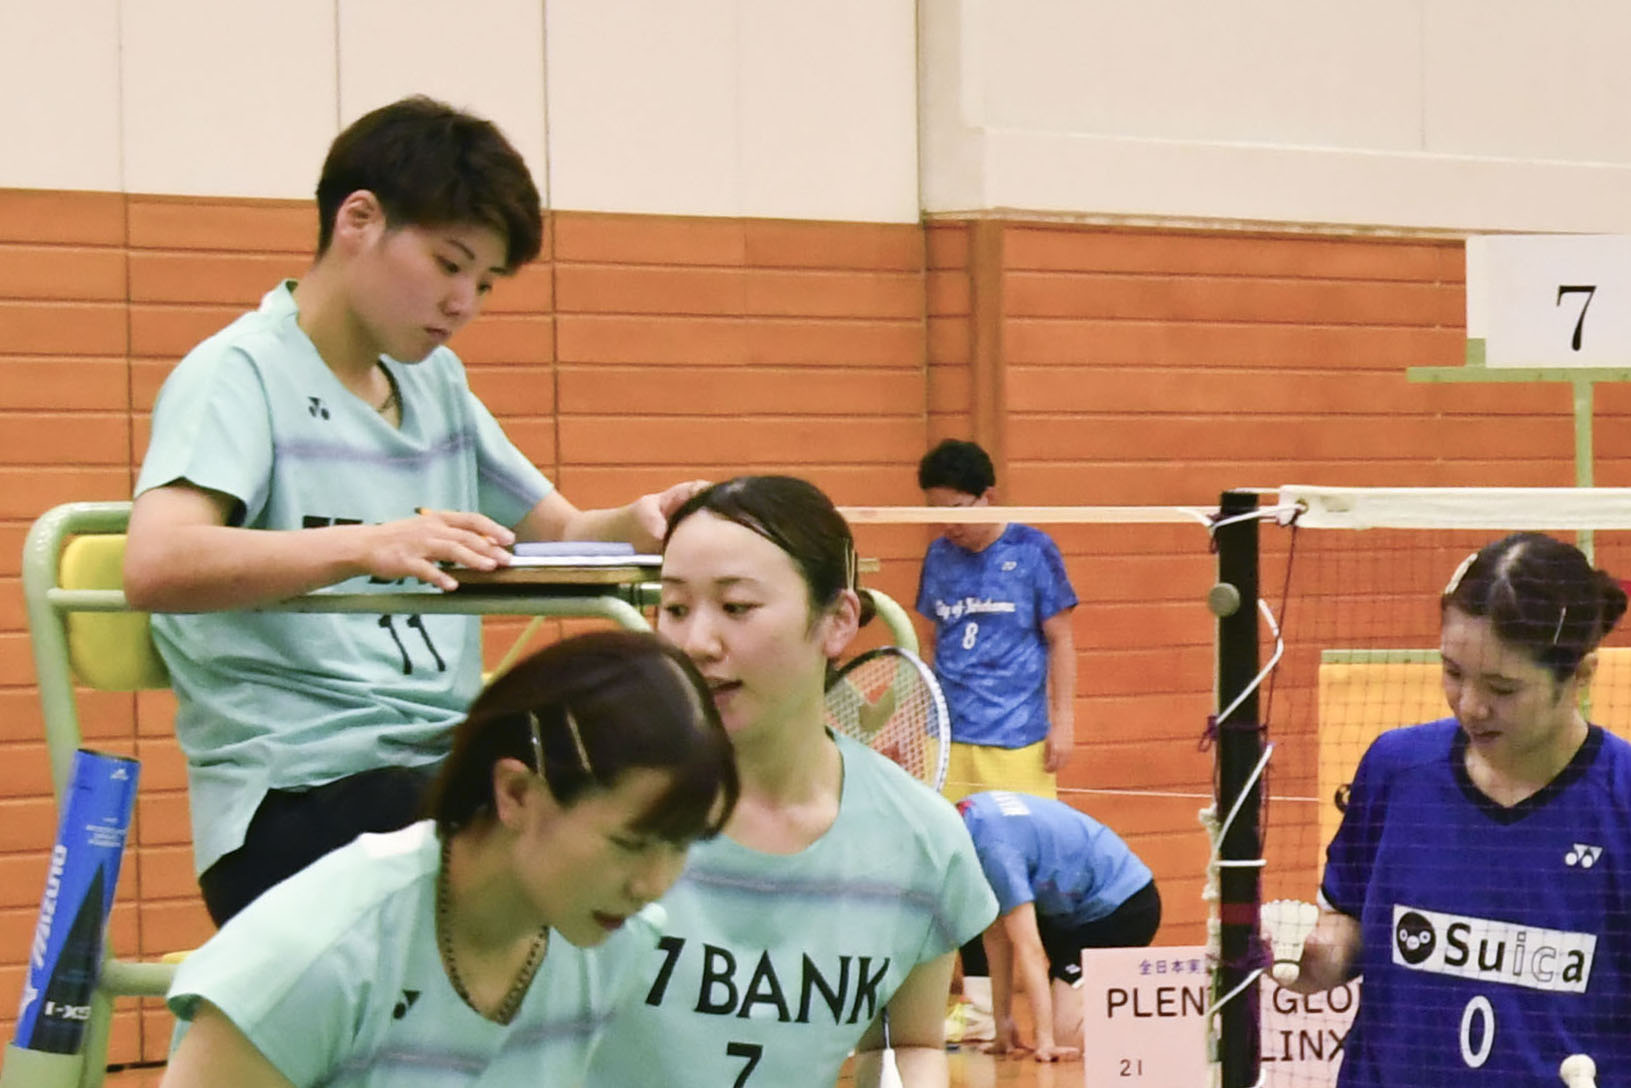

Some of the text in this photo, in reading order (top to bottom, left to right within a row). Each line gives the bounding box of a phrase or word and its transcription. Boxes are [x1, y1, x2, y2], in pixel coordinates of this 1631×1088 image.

[1556, 285, 1597, 351] 7
[962, 622, 978, 649] 8
[1444, 922, 1586, 983] Suica
[693, 943, 890, 1026] BANK
[1107, 985, 1213, 1019] PLEN
[1460, 995, 1494, 1068] 0
[1120, 1058, 1142, 1077] 21
